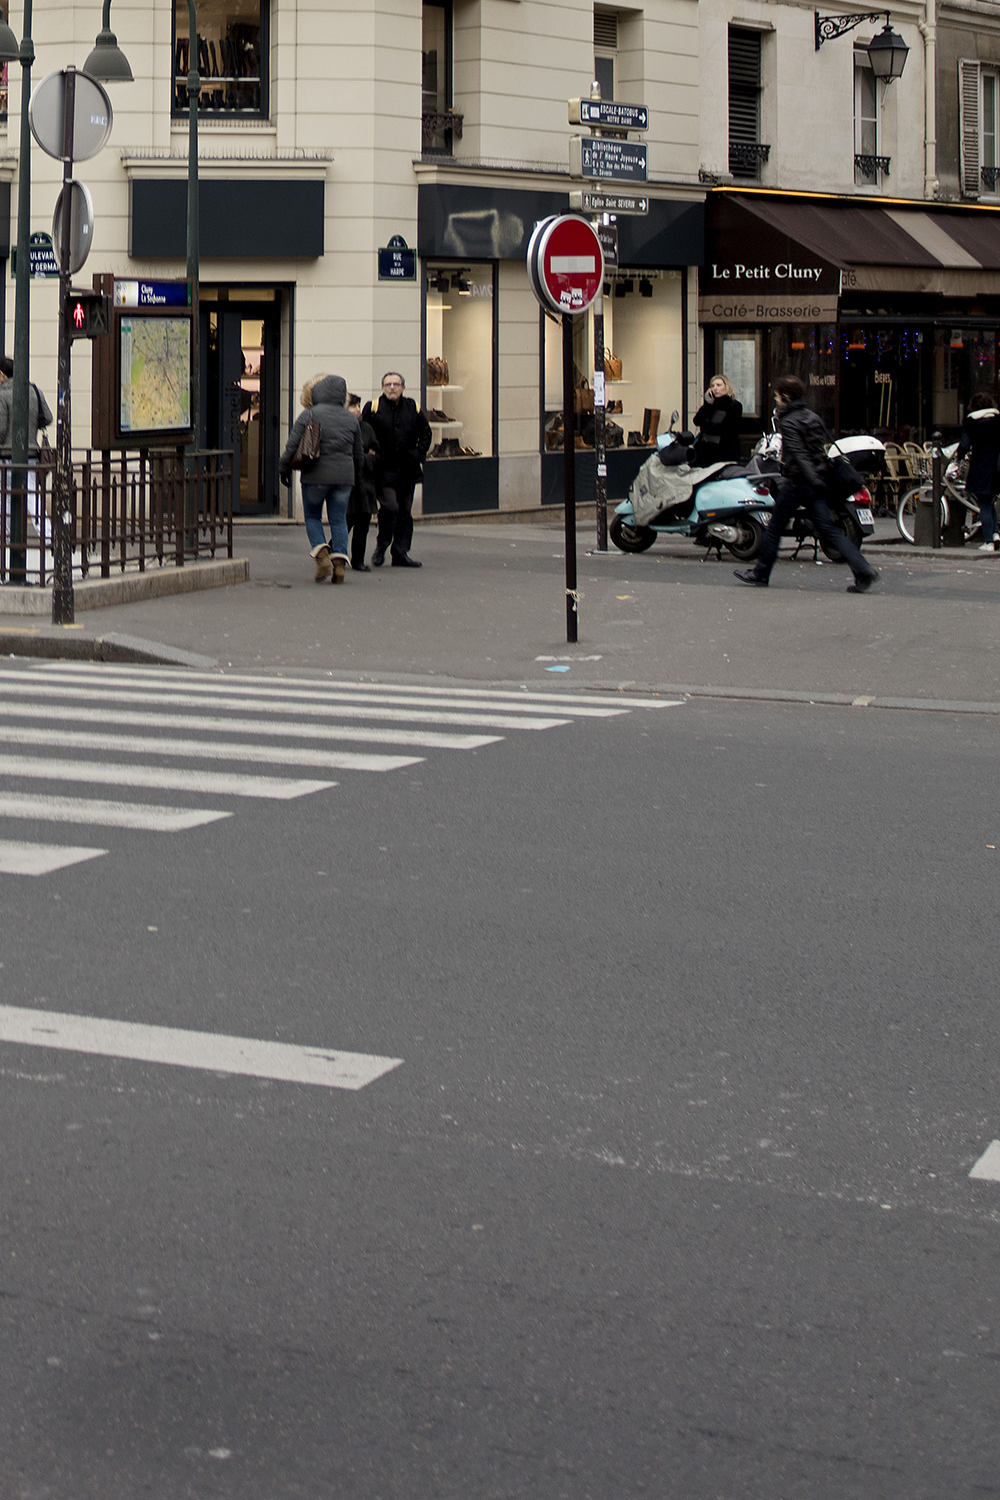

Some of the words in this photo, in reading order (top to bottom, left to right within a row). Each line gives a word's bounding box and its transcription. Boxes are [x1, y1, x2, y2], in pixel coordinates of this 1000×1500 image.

[30, 251, 56, 260] ULEVAR
[712, 264, 730, 279] Le
[735, 264, 771, 279] Petit
[775, 263, 823, 281] Cluny
